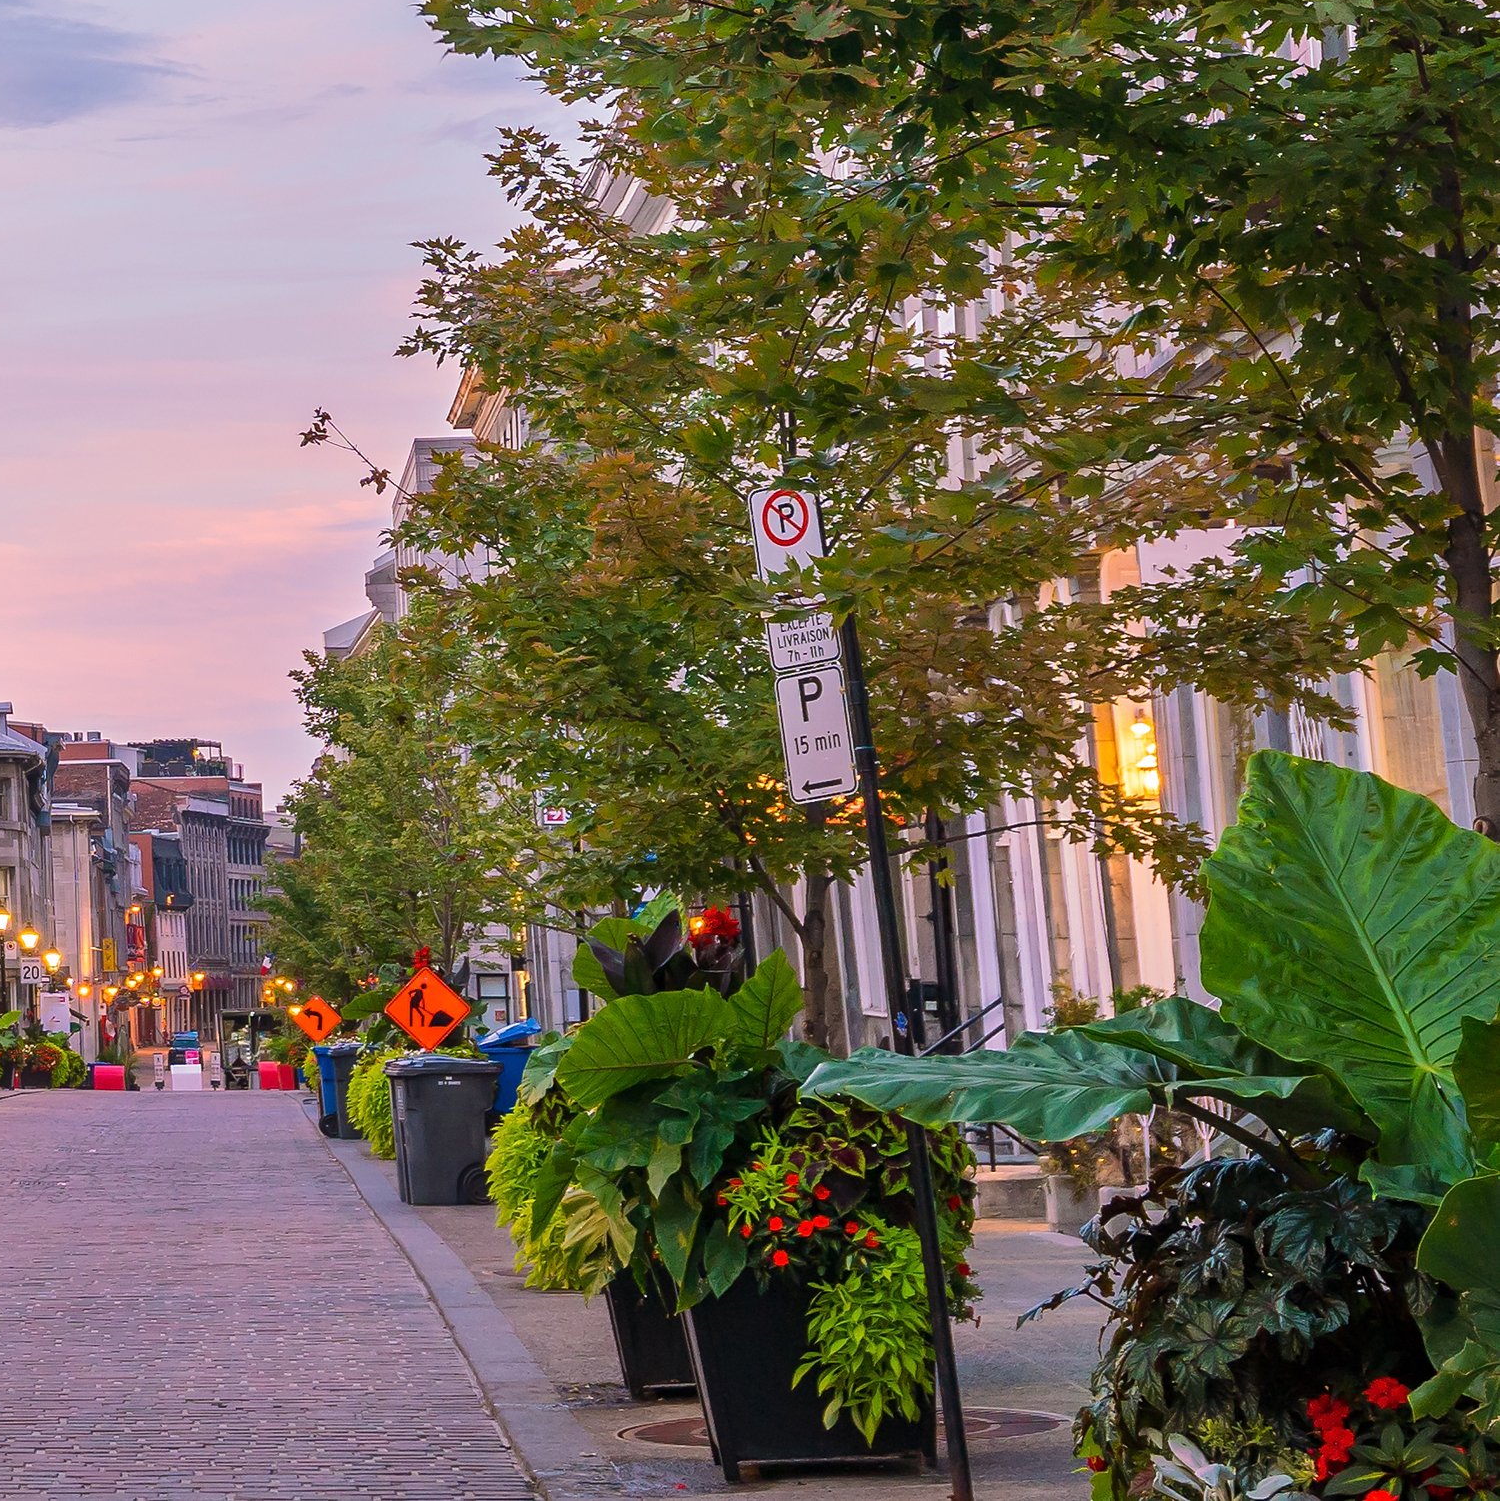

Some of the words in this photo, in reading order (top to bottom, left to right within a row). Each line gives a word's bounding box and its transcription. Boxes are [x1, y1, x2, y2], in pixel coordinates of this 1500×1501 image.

[777, 627, 830, 649] LIVRAISON
[788, 650, 801, 662] 7h
[810, 645, 824, 658] 11h
[798, 675, 823, 722] P
[794, 735, 809, 755] 15
[815, 730, 841, 751] min
[23, 966, 39, 979] 20
